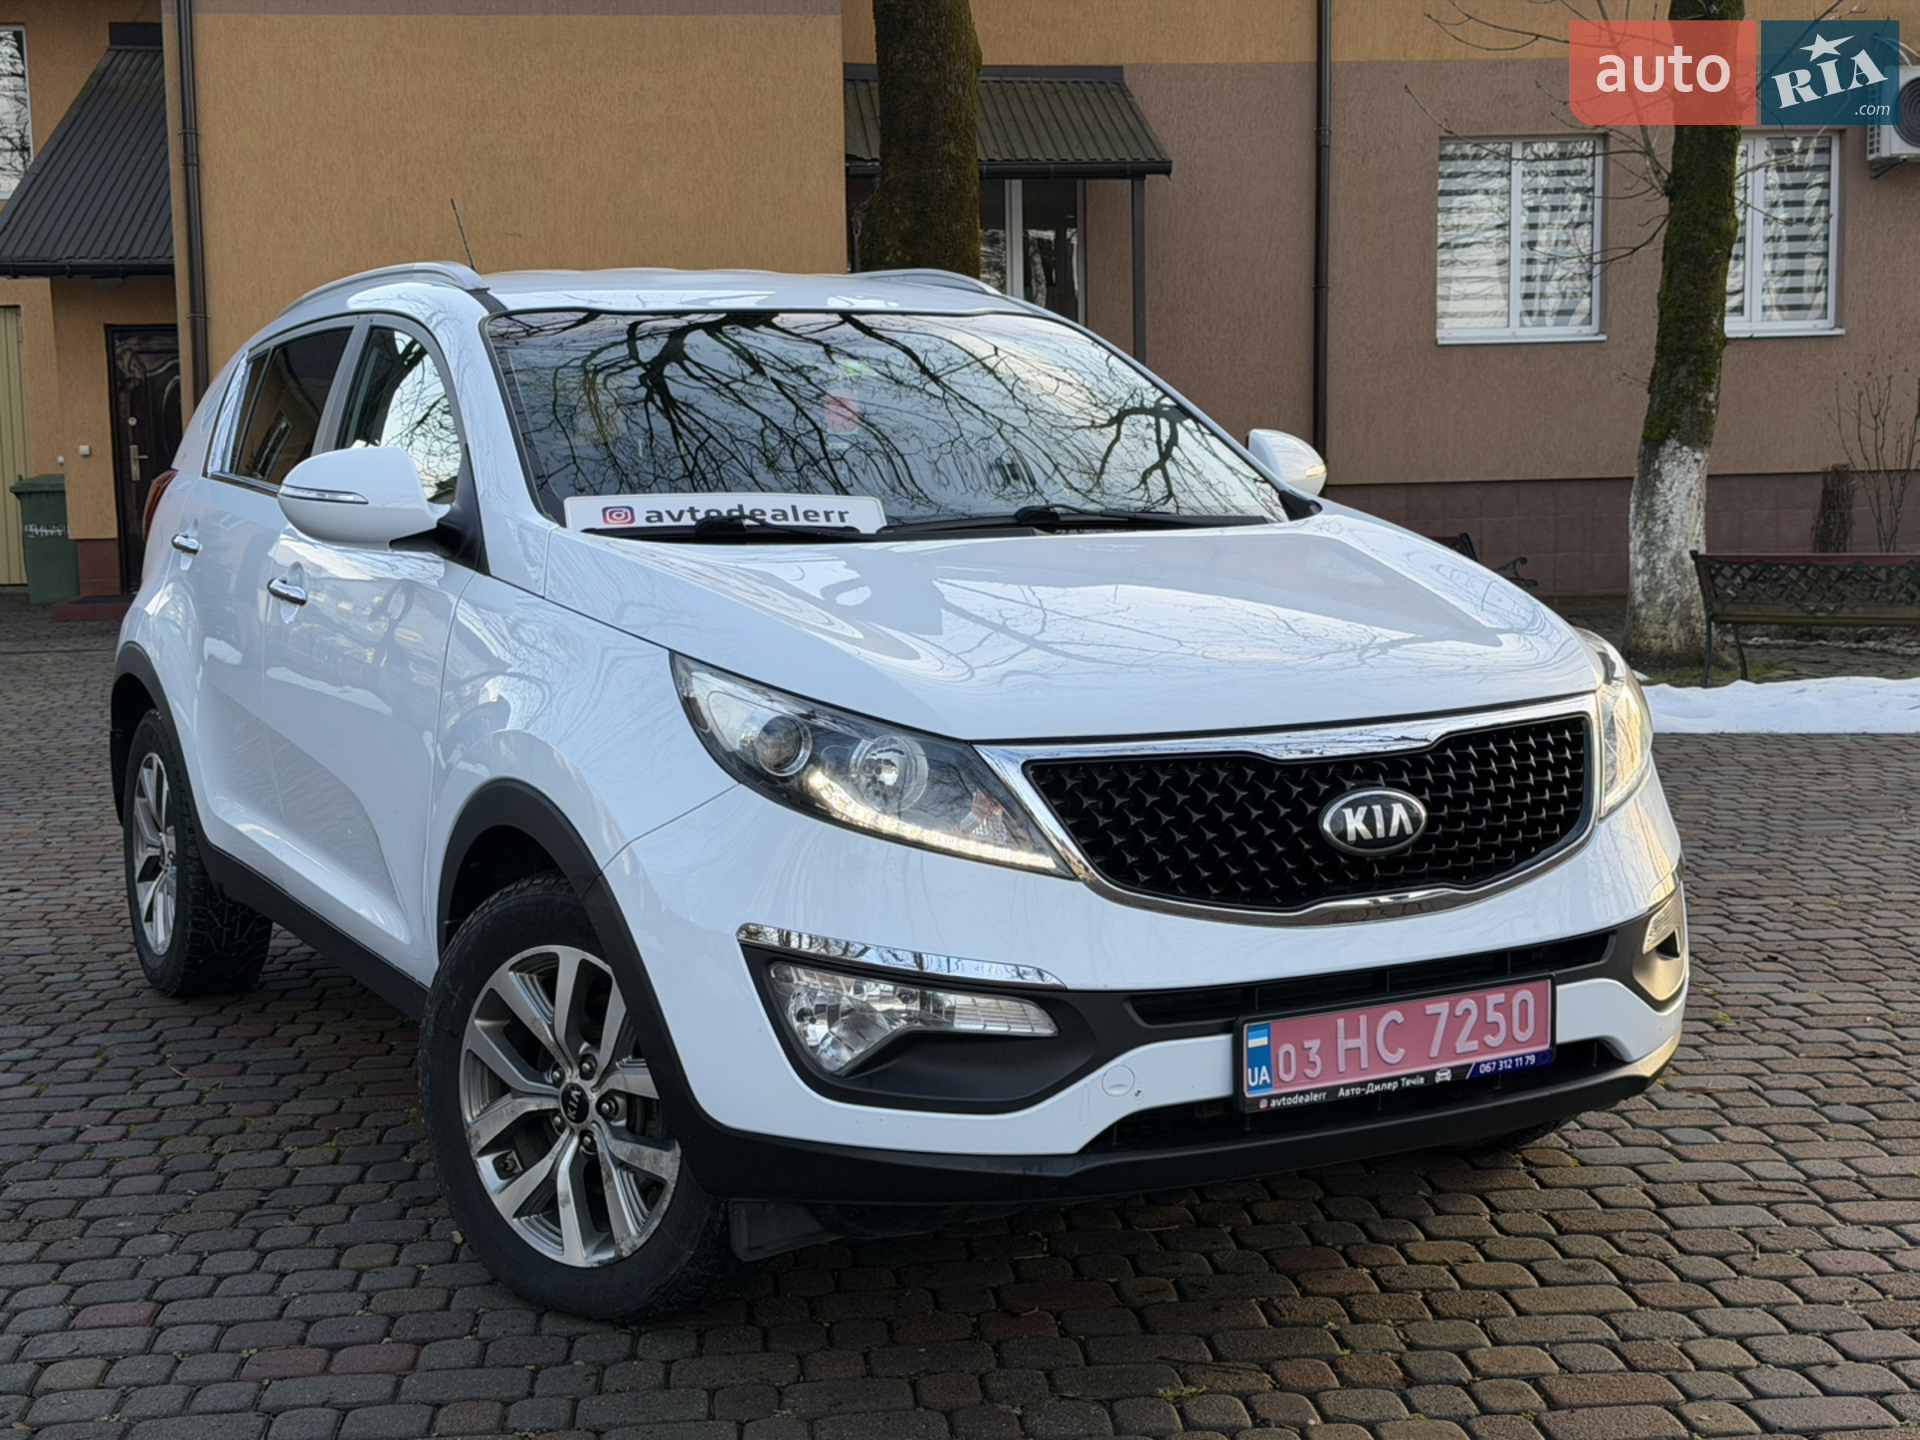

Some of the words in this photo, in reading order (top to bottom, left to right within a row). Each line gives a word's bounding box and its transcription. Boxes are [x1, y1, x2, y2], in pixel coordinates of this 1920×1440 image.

[644, 503, 850, 524] avtodealerr
[1341, 802, 1414, 843] KIA
[1276, 1039, 1322, 1083] 03
[1336, 1010, 1406, 1073] HC
[1424, 989, 1535, 1059] 7250
[1479, 1061, 1497, 1075] 067
[1498, 1058, 1513, 1071] 312
[1514, 1056, 1523, 1068] 11
[1524, 1054, 1536, 1066] 79
[1247, 1065, 1271, 1087] UA
[1270, 1091, 1327, 1108] avtodealerr
[1338, 1080, 1399, 1098] Авто-Дилер
[567, 1090, 581, 1121] KIA
